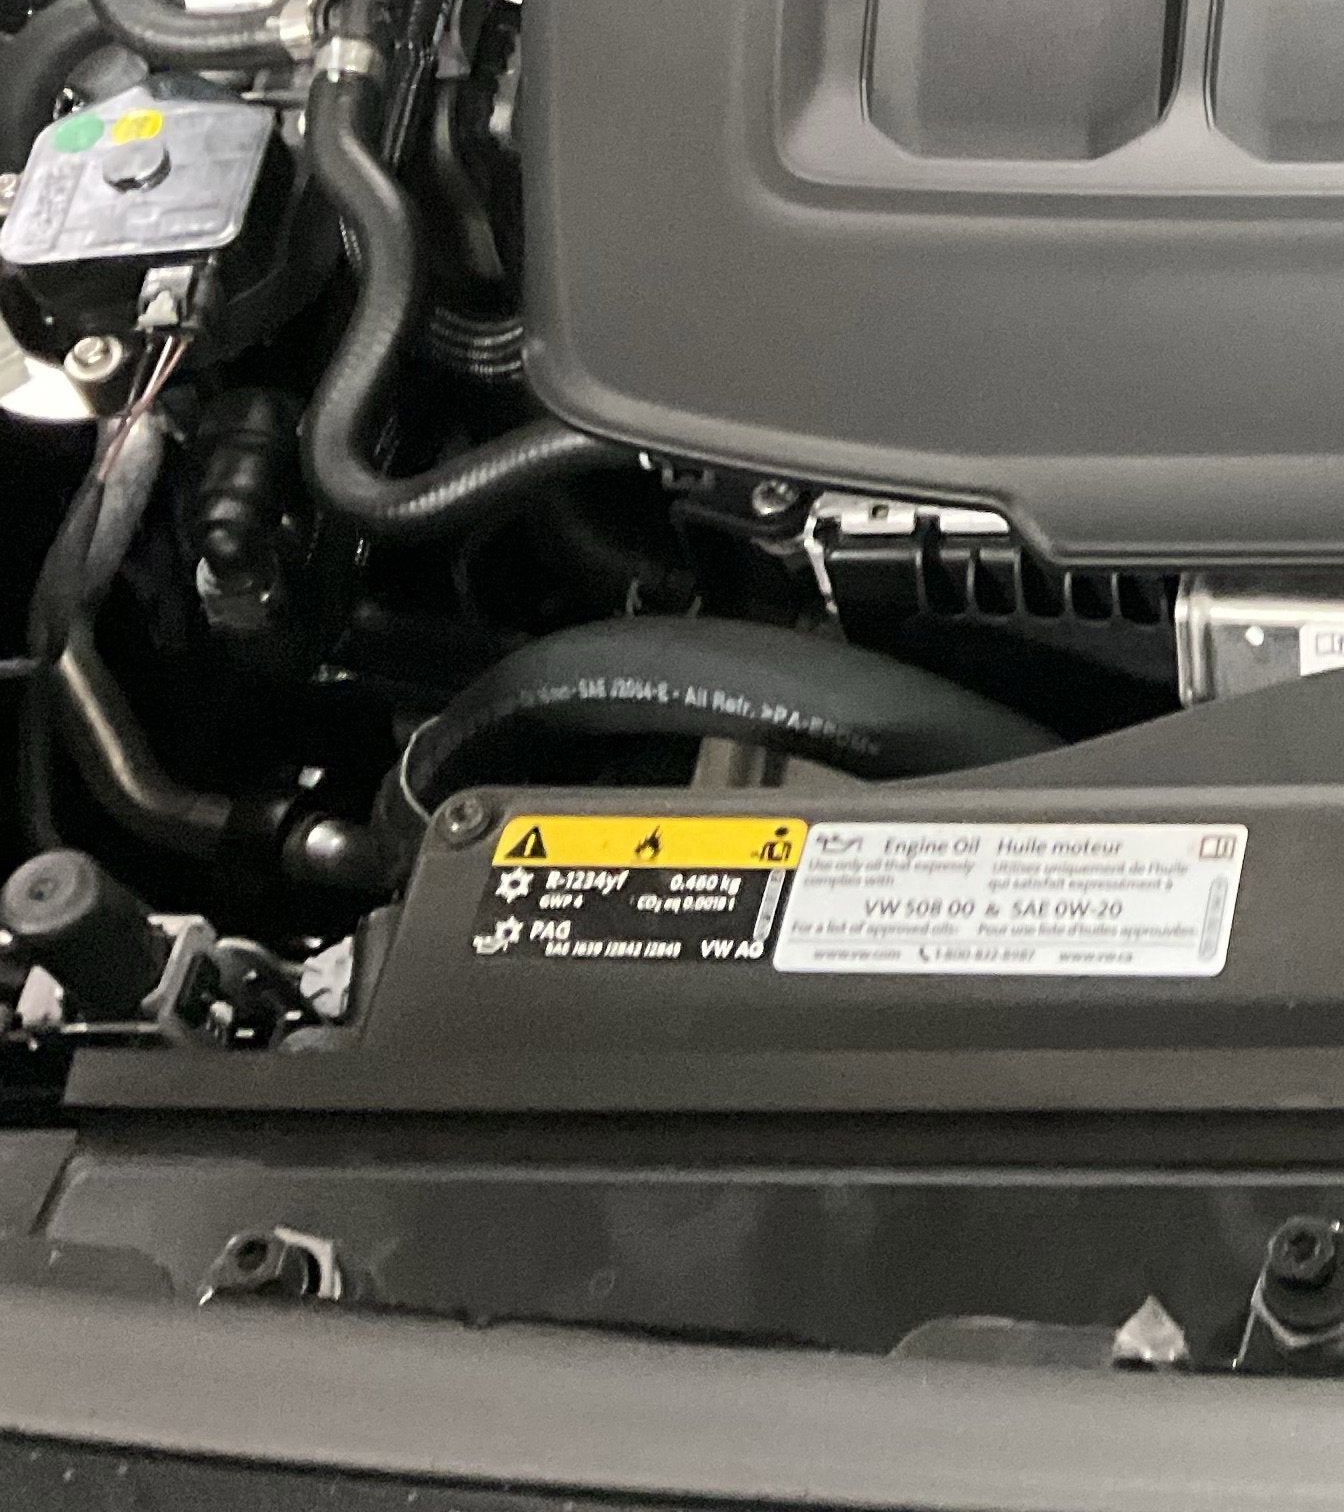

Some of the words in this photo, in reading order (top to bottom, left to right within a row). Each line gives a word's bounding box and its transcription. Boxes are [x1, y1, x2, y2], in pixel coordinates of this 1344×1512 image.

[883, 835, 949, 857] Engine
[952, 835, 980, 855] Oil
[996, 837, 1048, 856] Huile
[1051, 838, 1125, 856] moteur
[545, 869, 630, 895] R-1234yf
[719, 875, 742, 895] kg
[864, 898, 901, 917] VW
[904, 899, 942, 917] 508
[947, 899, 976, 918] 00
[983, 904, 1001, 918] &
[1012, 900, 1047, 918] SAE
[1054, 900, 1124, 919] 0W-20
[529, 919, 572, 940] PAG
[699, 938, 734, 959] VW
[733, 940, 765, 960] AG
